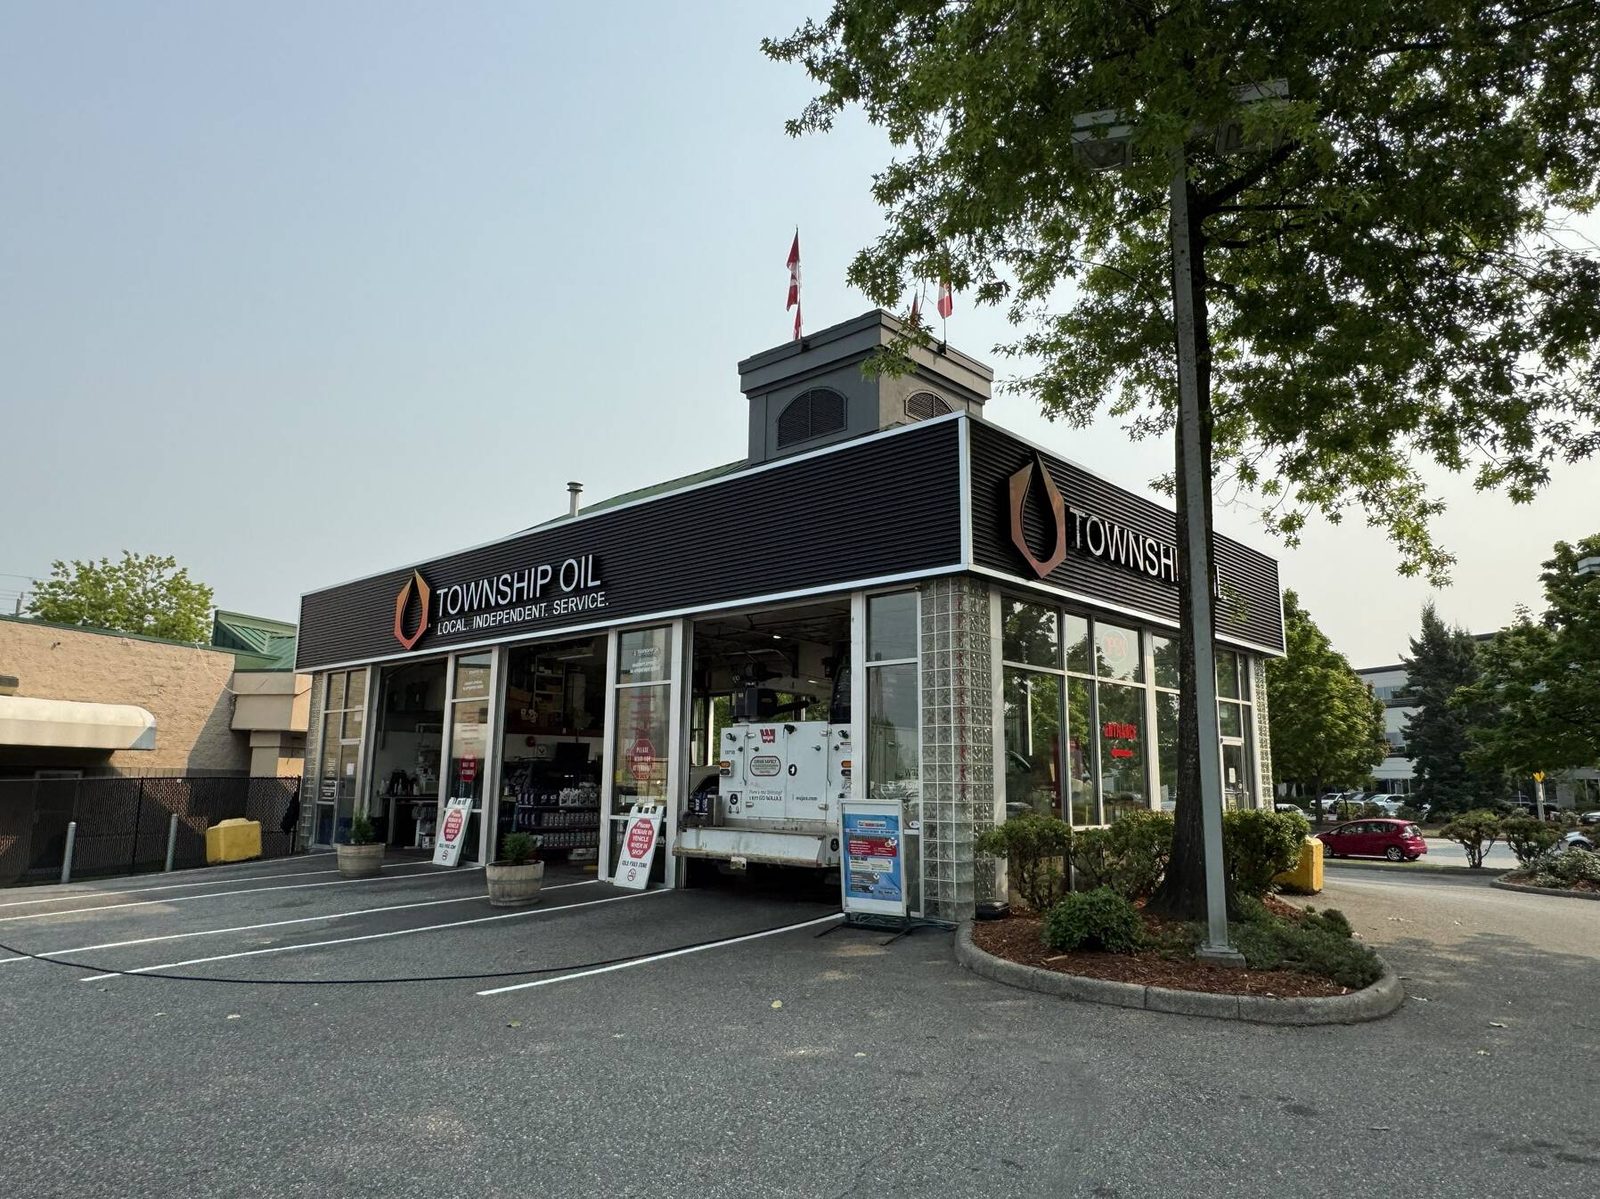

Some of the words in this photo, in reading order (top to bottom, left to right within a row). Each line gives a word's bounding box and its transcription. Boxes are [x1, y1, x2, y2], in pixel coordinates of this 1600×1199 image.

[1069, 507, 1179, 582] TOWNSHI
[436, 565, 552, 617] TOWNSHIP
[559, 554, 601, 593] OIL
[437, 618, 470, 635] LOCAL.
[473, 602, 548, 629] INDEPENDENT.
[553, 591, 609, 615] SERVICE.
